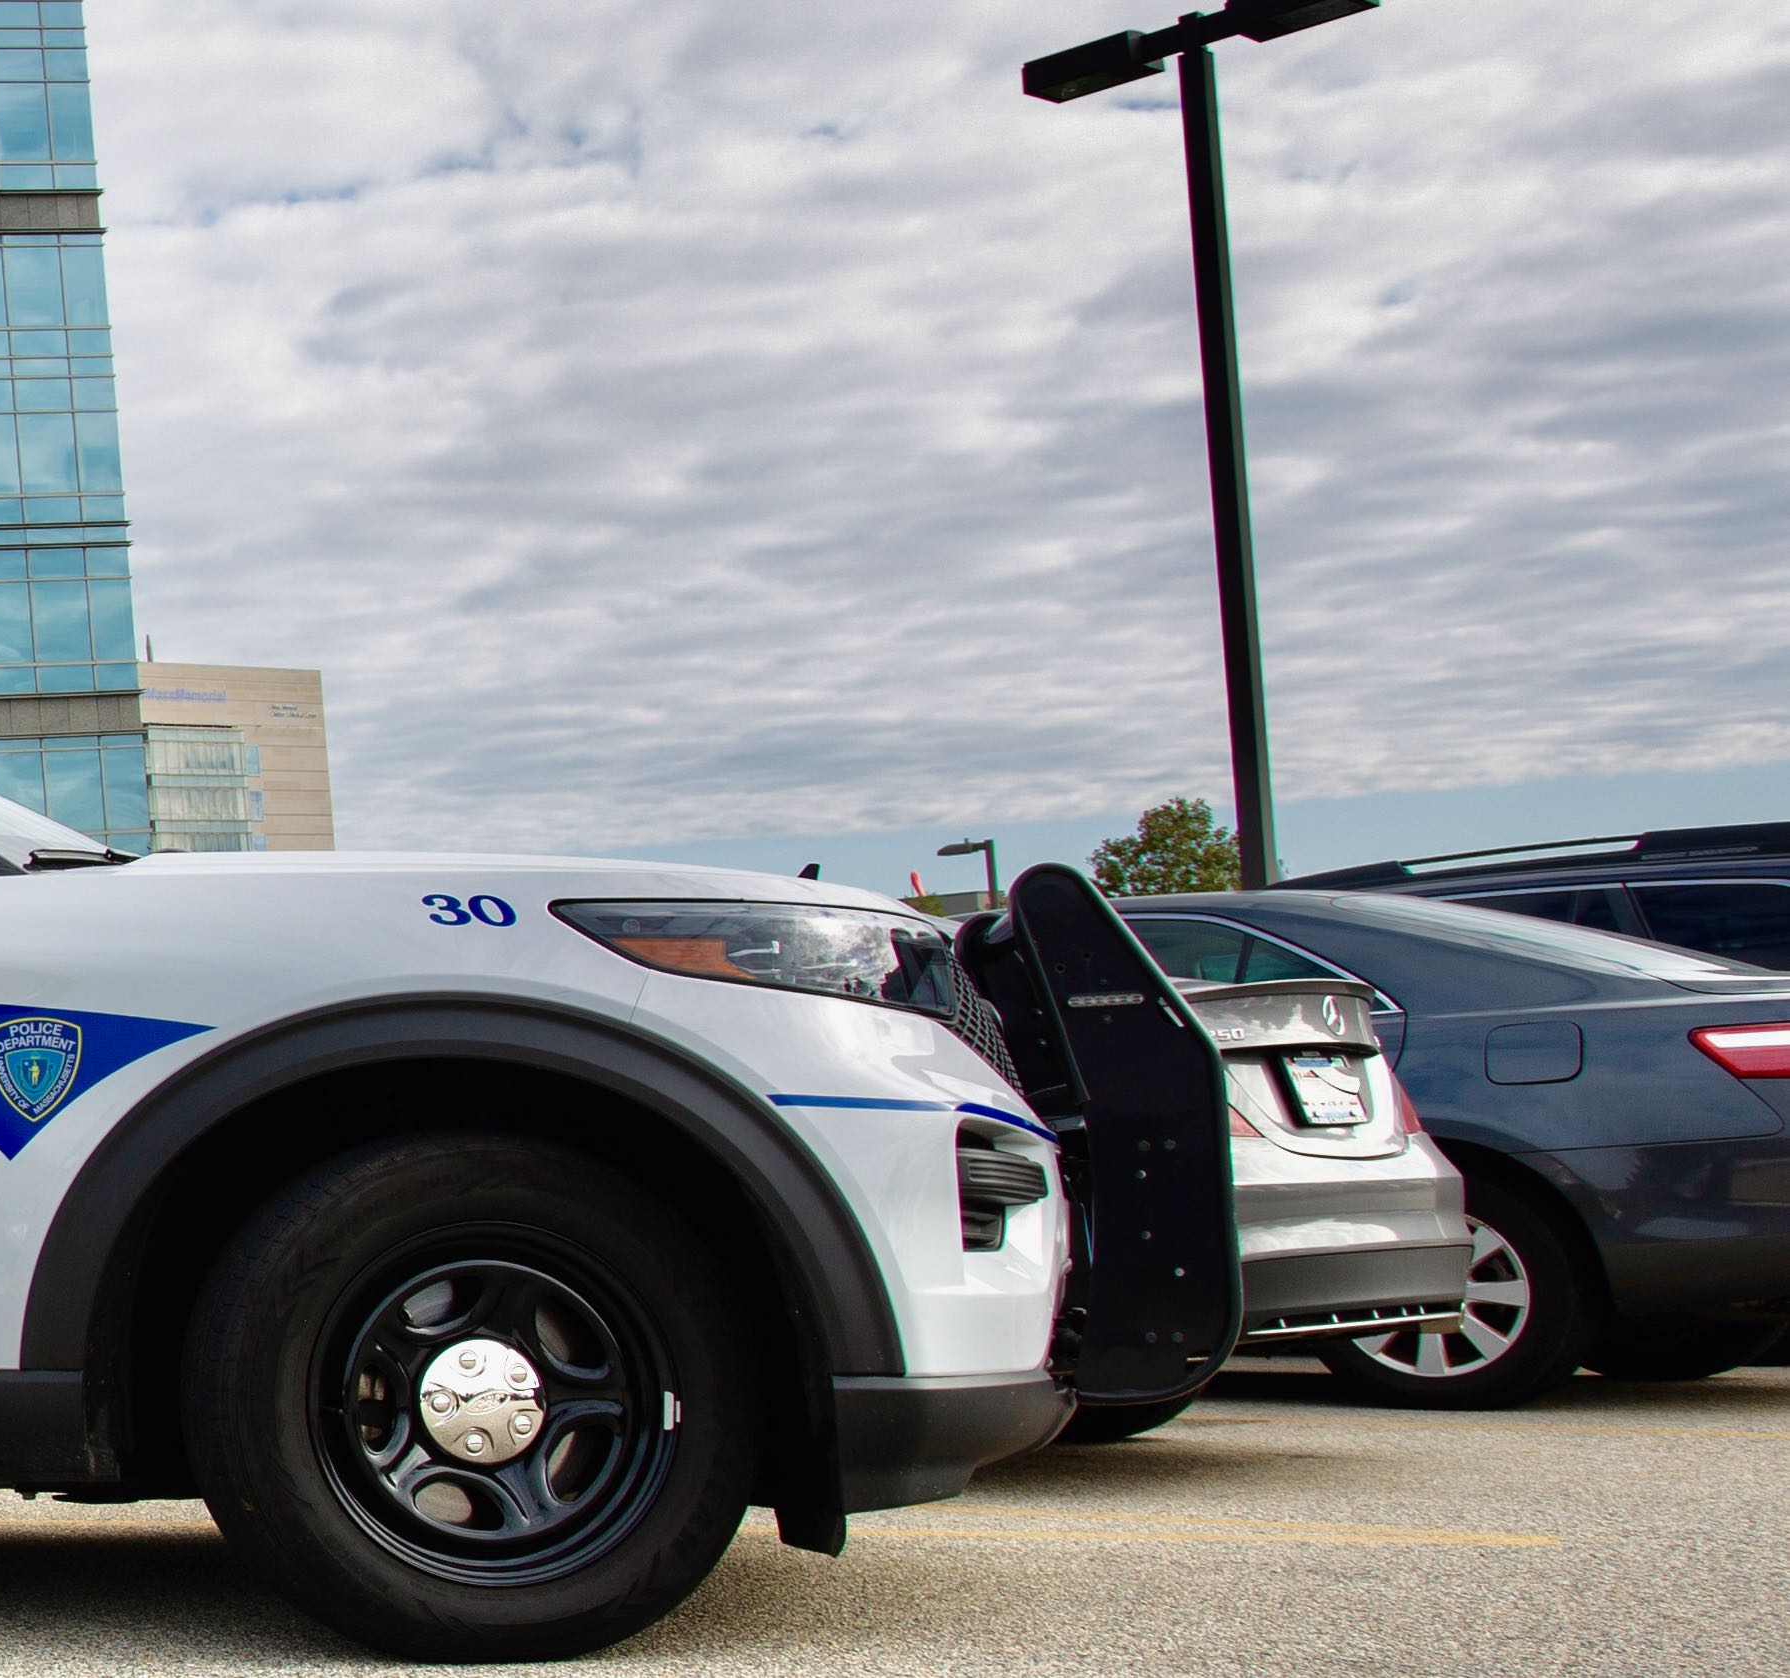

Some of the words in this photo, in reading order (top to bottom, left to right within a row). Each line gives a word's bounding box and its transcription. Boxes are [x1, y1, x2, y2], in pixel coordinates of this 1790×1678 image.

[422, 893, 517, 927] 30
[9, 1022, 64, 1037] POLICE
[32, 1053, 76, 1115] MASSACHUSETTS
[17, 1096, 31, 1110] OF
